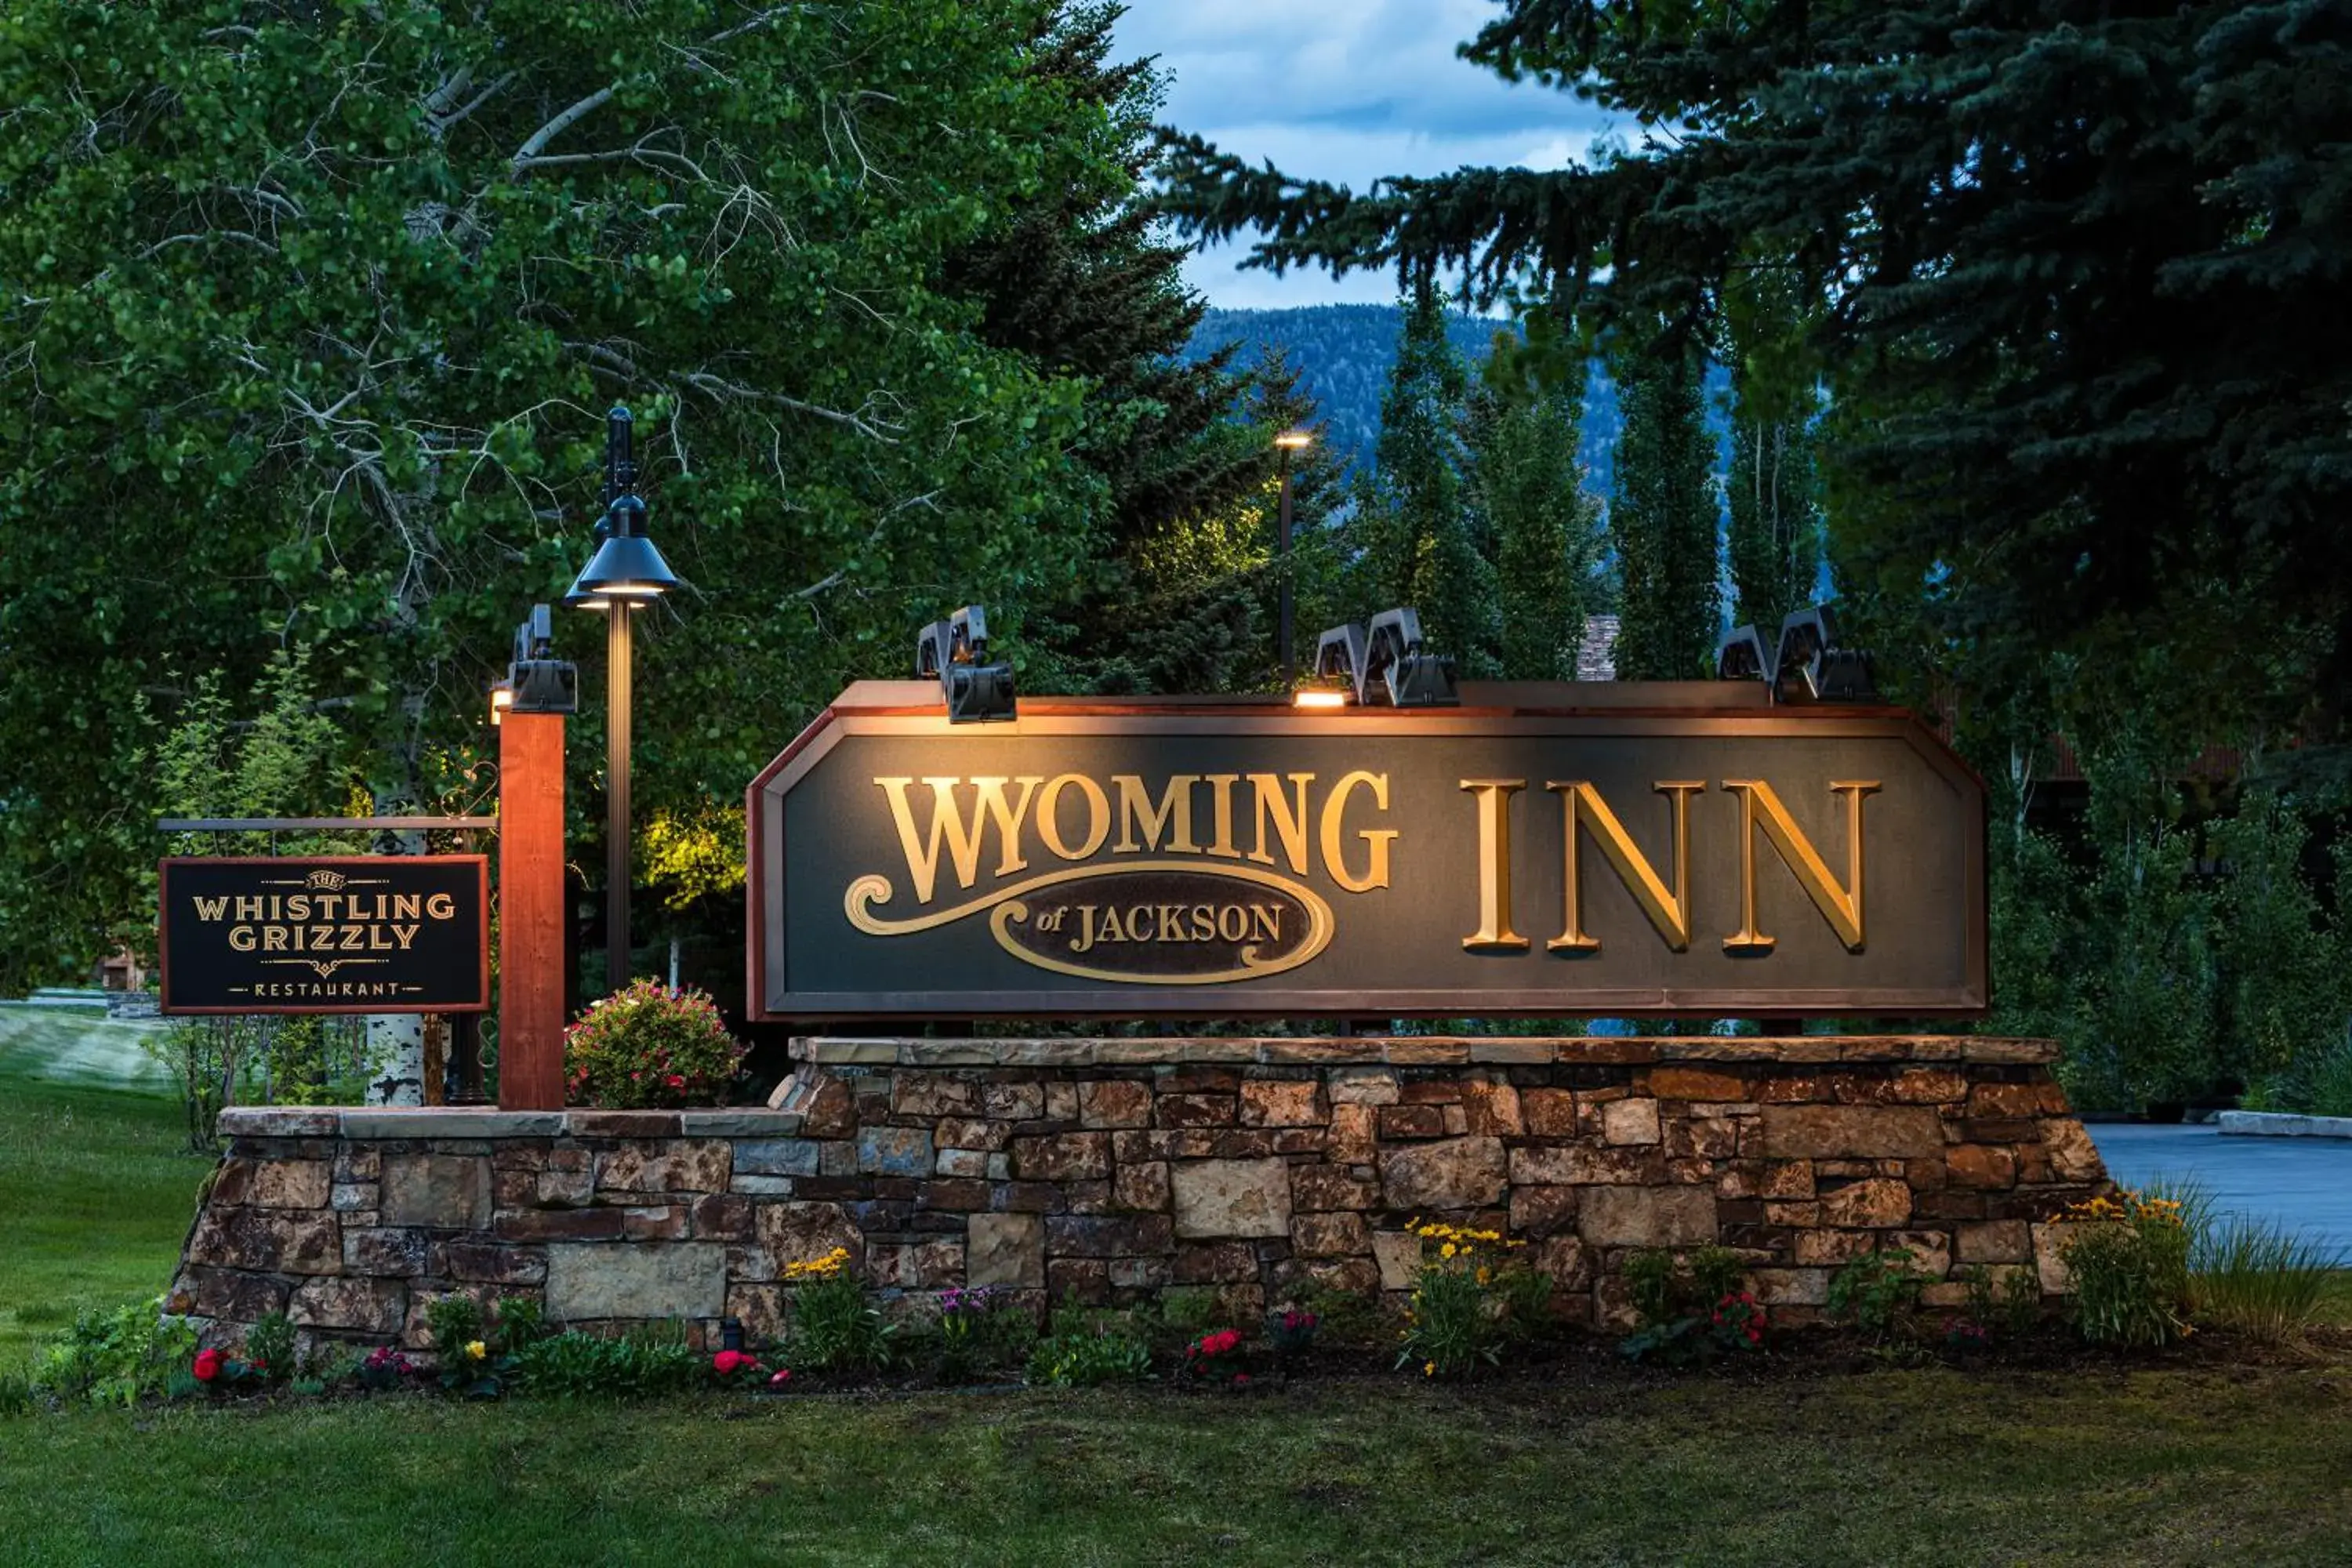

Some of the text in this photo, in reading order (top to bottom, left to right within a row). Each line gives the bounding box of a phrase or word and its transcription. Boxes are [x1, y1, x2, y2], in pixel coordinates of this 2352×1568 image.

[873, 770, 1881, 954] WYOMING INN
[313, 873, 339, 887] THE
[192, 893, 456, 921] WHISTLING
[228, 924, 421, 951] GRIZZLY
[1036, 903, 1285, 952] of JACKSON
[254, 982, 400, 996] RESTAURANT
